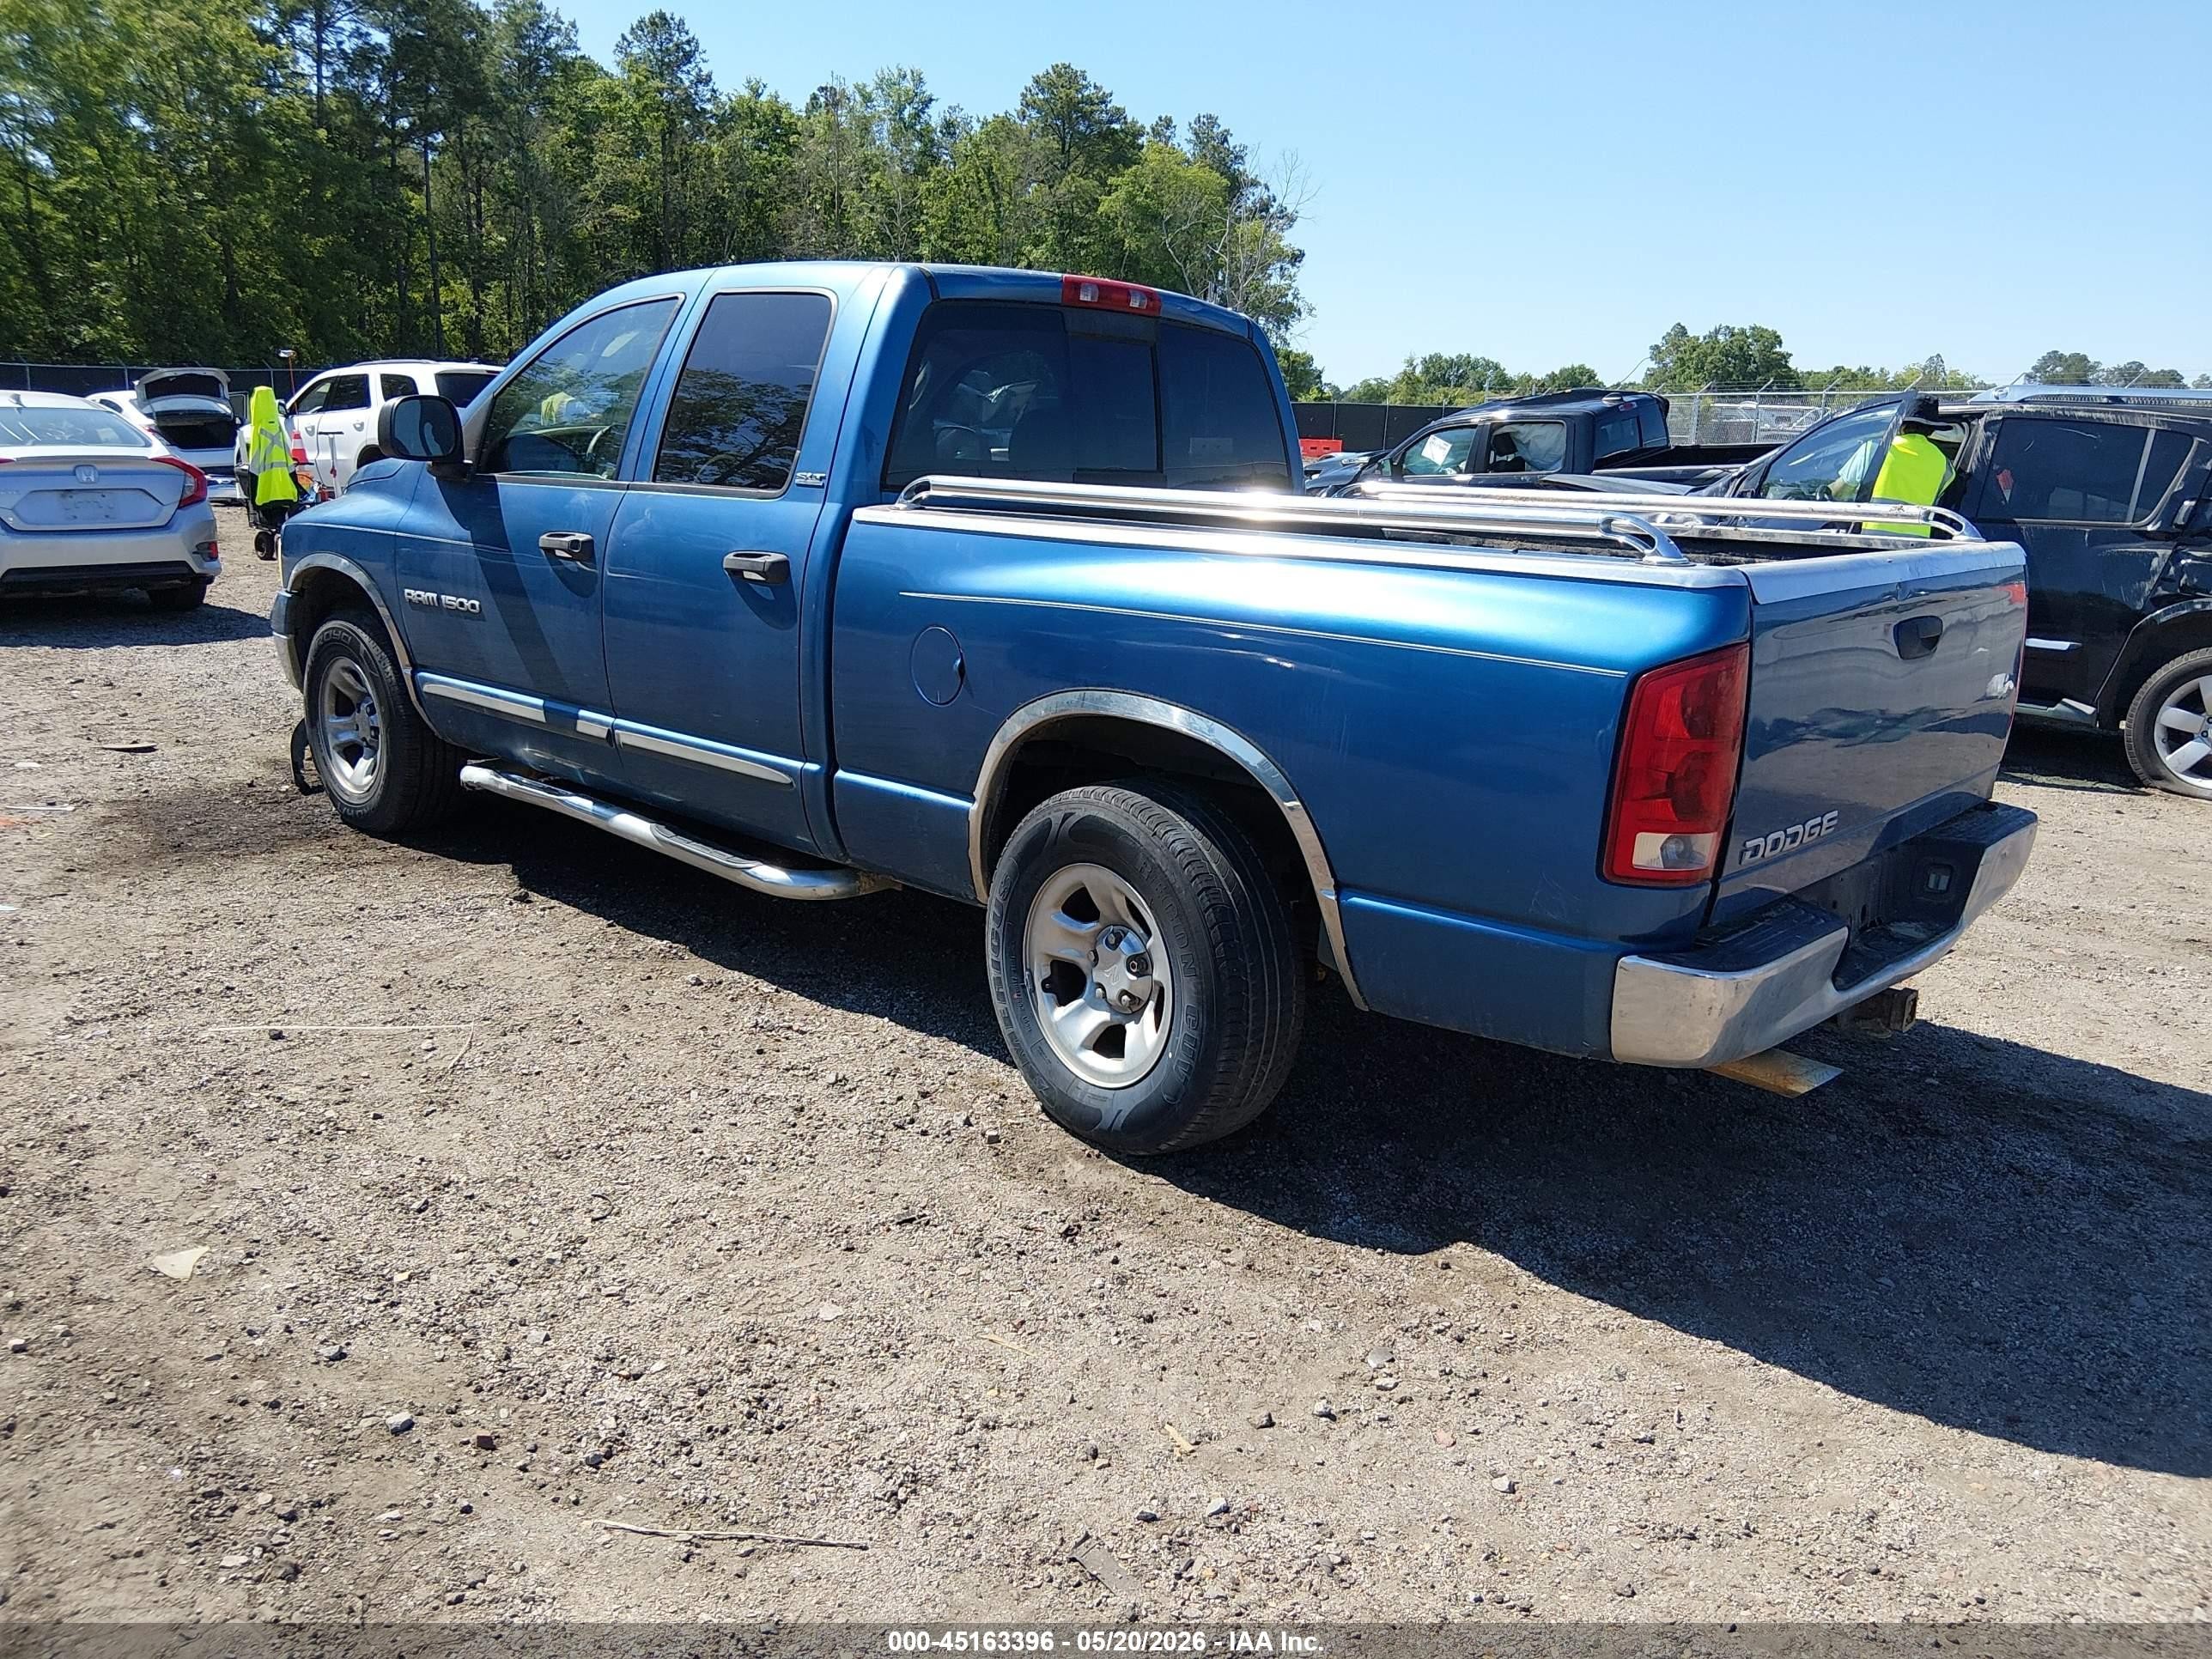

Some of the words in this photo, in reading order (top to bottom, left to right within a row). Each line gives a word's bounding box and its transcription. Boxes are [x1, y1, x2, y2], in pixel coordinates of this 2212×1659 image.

[404, 588, 439, 607] RAM
[441, 594, 481, 614] 1500
[1739, 810, 1838, 866] DODGE
